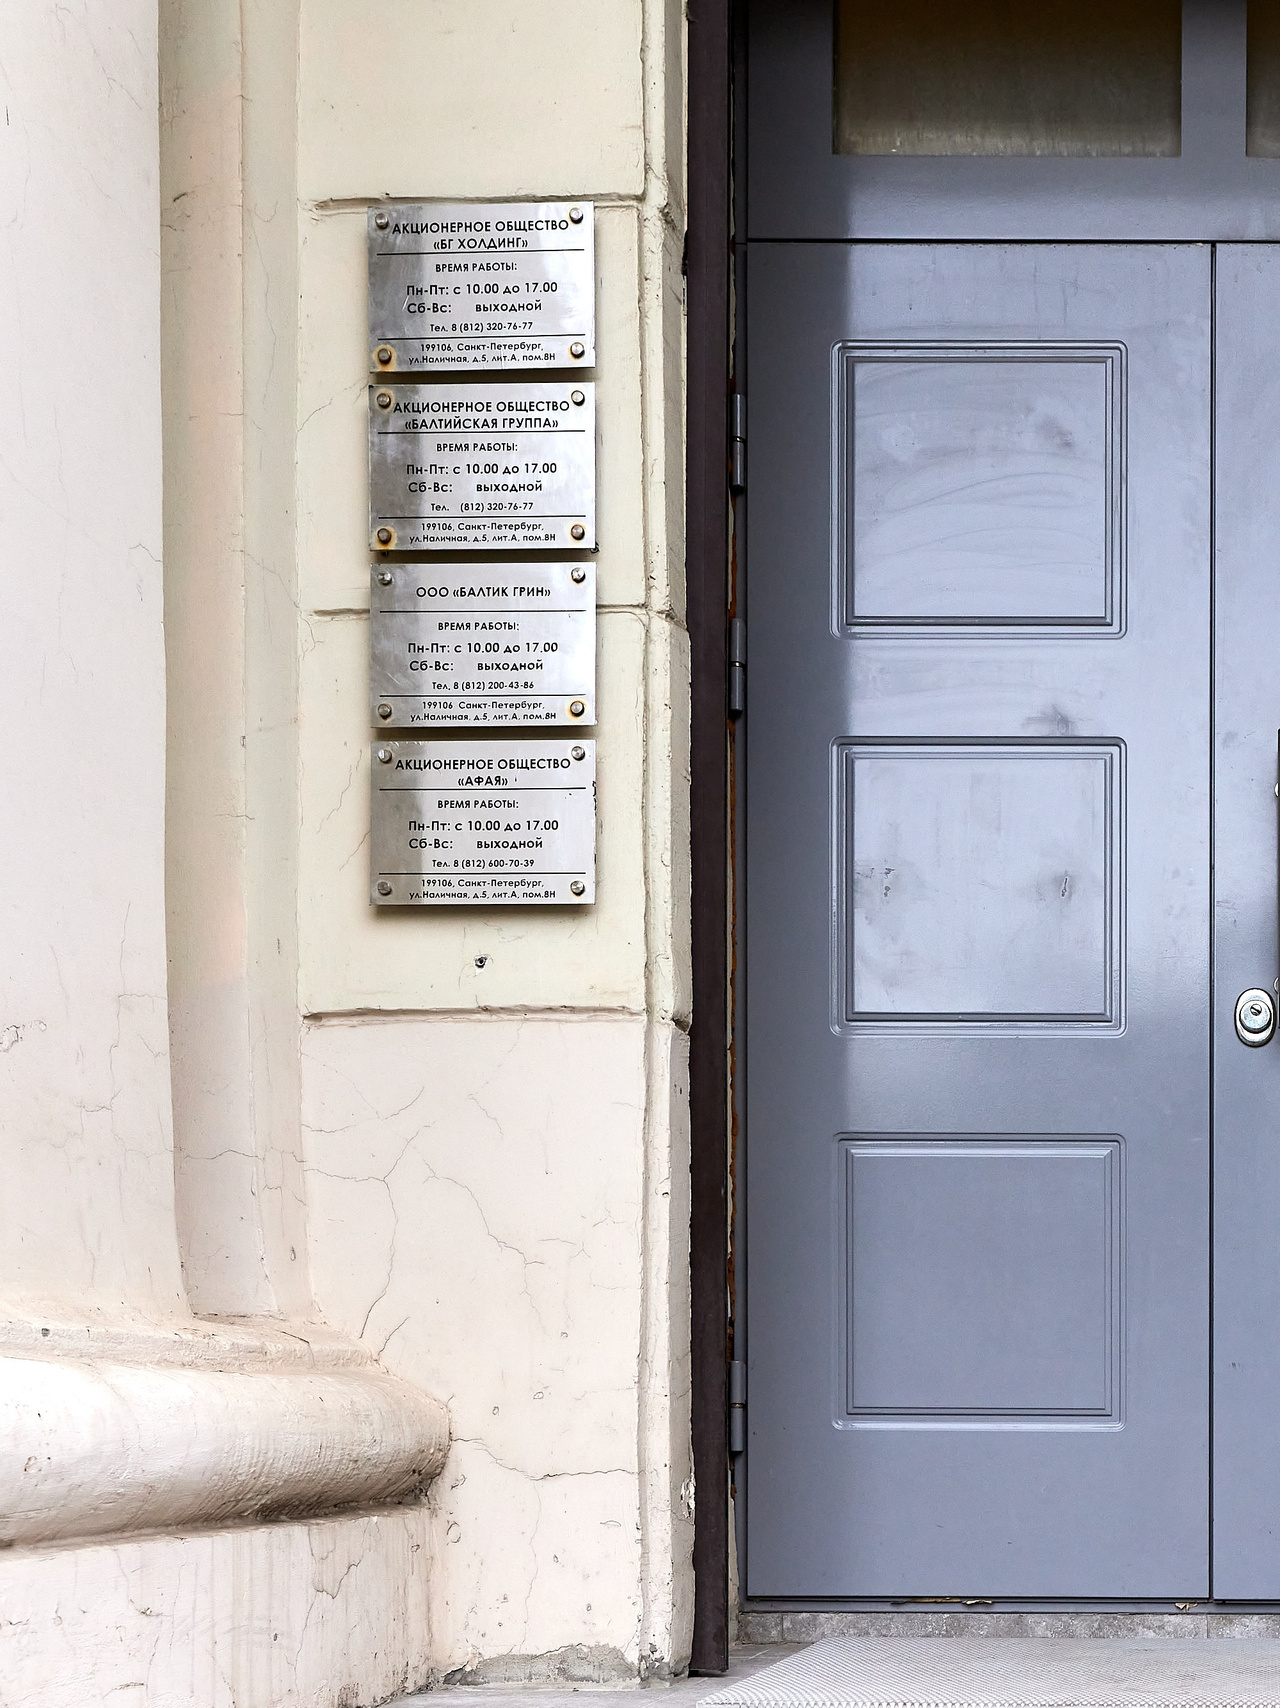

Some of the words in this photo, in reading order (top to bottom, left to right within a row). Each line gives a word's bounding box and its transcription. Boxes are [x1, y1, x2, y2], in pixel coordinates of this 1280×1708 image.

[392, 222, 490, 235] АКЦИОНЕРНОЕ
[495, 220, 568, 232] ОБЩЕСТВО
[434, 239, 453, 249] «БГ
[458, 238, 527, 249] ХОЛДИНГ»
[436, 264, 468, 272] ВРЕМЯ
[472, 262, 517, 271] РАБОТЫ:
[407, 285, 448, 296] Пн-Пт:
[467, 284, 499, 294] 10.00
[503, 286, 519, 294] до
[526, 282, 557, 292] 17.00
[407, 303, 451, 313] Сб-Вс:
[476, 300, 541, 312] выходной
[430, 324, 448, 332] Тел.
[460, 323, 483, 333] (812)
[487, 322, 532, 330] 320-76-77
[523, 353, 555, 361] пом.8Н
[393, 402, 492, 413] АКЦИОНЕРНОЕ
[497, 401, 569, 413] ОБЩЕСТВО
[405, 416, 498, 430] «БАЛТИЙСКАЯ
[503, 418, 558, 428] ГРУППА»
[473, 443, 517, 451] РАБОТЫ:
[406, 465, 449, 475] Пн-Пт:
[466, 464, 498, 474] 10.00
[503, 466, 519, 474] до
[525, 463, 556, 473] 17.00
[408, 482, 452, 493] Сб-Вс:
[477, 480, 542, 492] выходной
[461, 503, 484, 512] (812)
[416, 587, 449, 597] ООО
[453, 587, 508, 597] «БАЛТИК
[514, 587, 550, 596] ГРИН»
[438, 622, 470, 630] ВРЕМЯ
[475, 622, 519, 630] РАБОТЫ:
[408, 643, 449, 653] Пн-Пт:
[454, 645, 461, 653] с
[468, 643, 499, 653] 10.00
[504, 645, 520, 653] до
[526, 643, 558, 652] 17.00
[410, 661, 453, 671] Сб-Вс:
[478, 660, 542, 671] выходной
[462, 682, 485, 691] (812)
[395, 759, 493, 772] АКЦИОНЕРНОЕ
[498, 759, 570, 770] ОБЩЕСТВО
[458, 776, 508, 786] «АФАЯ»
[438, 800, 470, 808] ВРЕМЯ
[474, 800, 518, 808] РАБОТЫ:
[409, 821, 450, 831] Пн-Пт:
[468, 821, 500, 830] 10.00
[504, 823, 521, 831] до
[527, 820, 558, 830] 17.00
[409, 838, 452, 849] Сб-Вс:
[477, 837, 542, 849] выходной
[432, 860, 450, 868] Тел.
[462, 860, 485, 869] (812)
